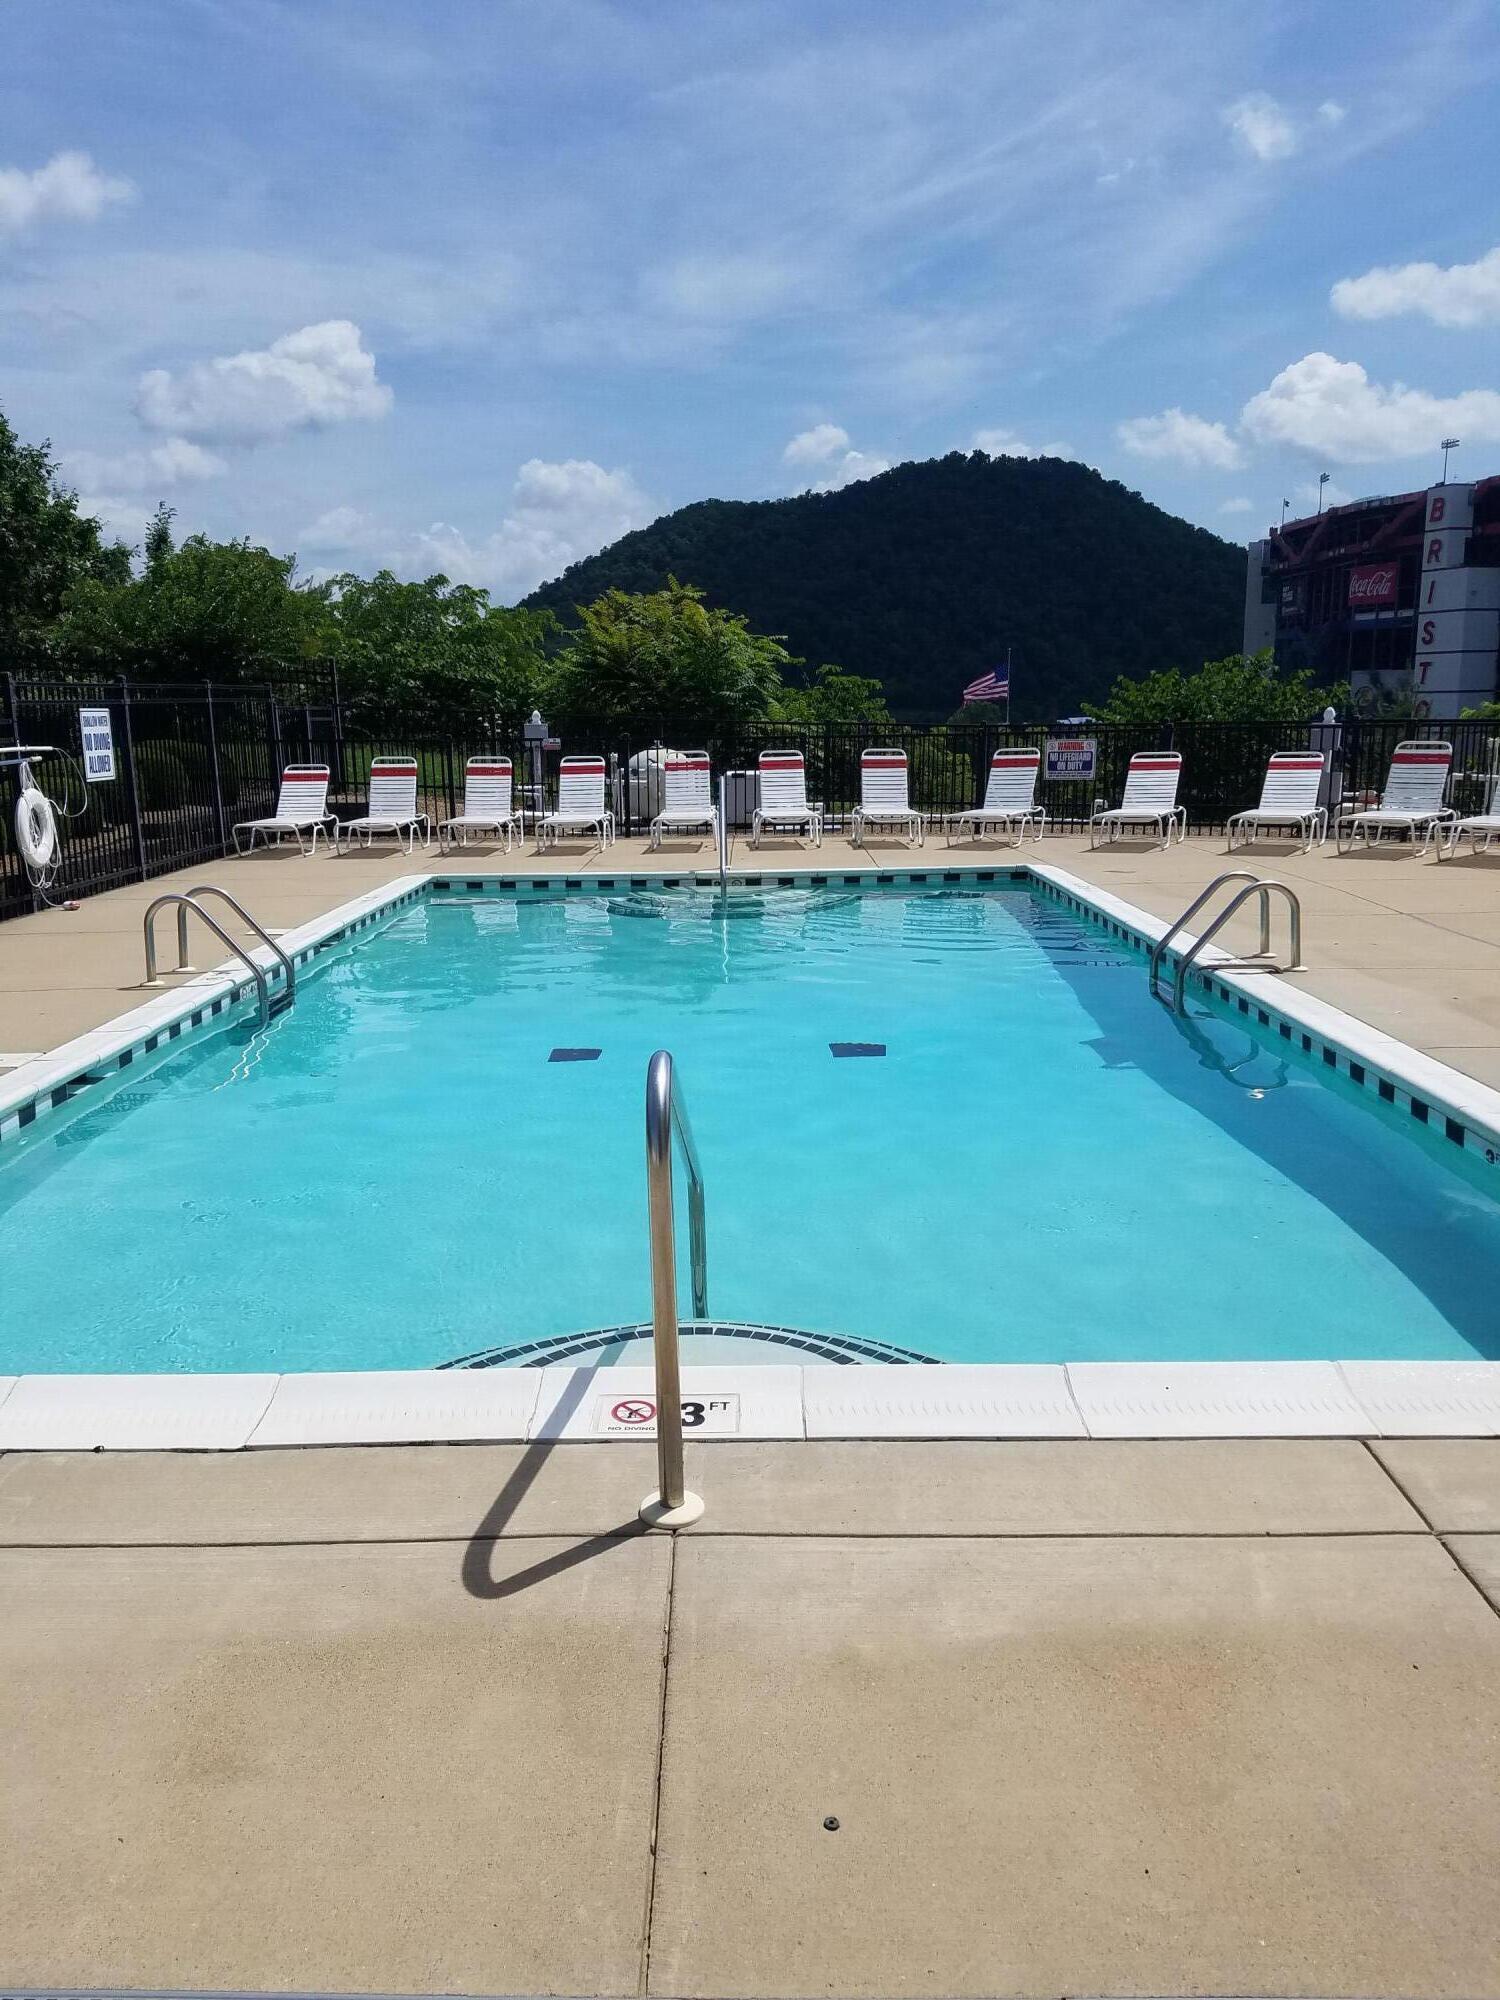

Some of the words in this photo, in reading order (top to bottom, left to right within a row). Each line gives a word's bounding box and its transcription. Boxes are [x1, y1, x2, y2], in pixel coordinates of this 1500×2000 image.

[84, 733, 93, 751] NO
[93, 732, 111, 750] DIVING
[1057, 741, 1085, 750] WARNING
[1049, 752, 1059, 761] NO
[1060, 752, 1092, 761] LIFEGUARD
[88, 755, 112, 773] ALLOWED
[1056, 761, 1066, 770] ON
[1067, 761, 1084, 770] DUTY
[681, 1402, 706, 1427] 3
[709, 1401, 730, 1411] FT
